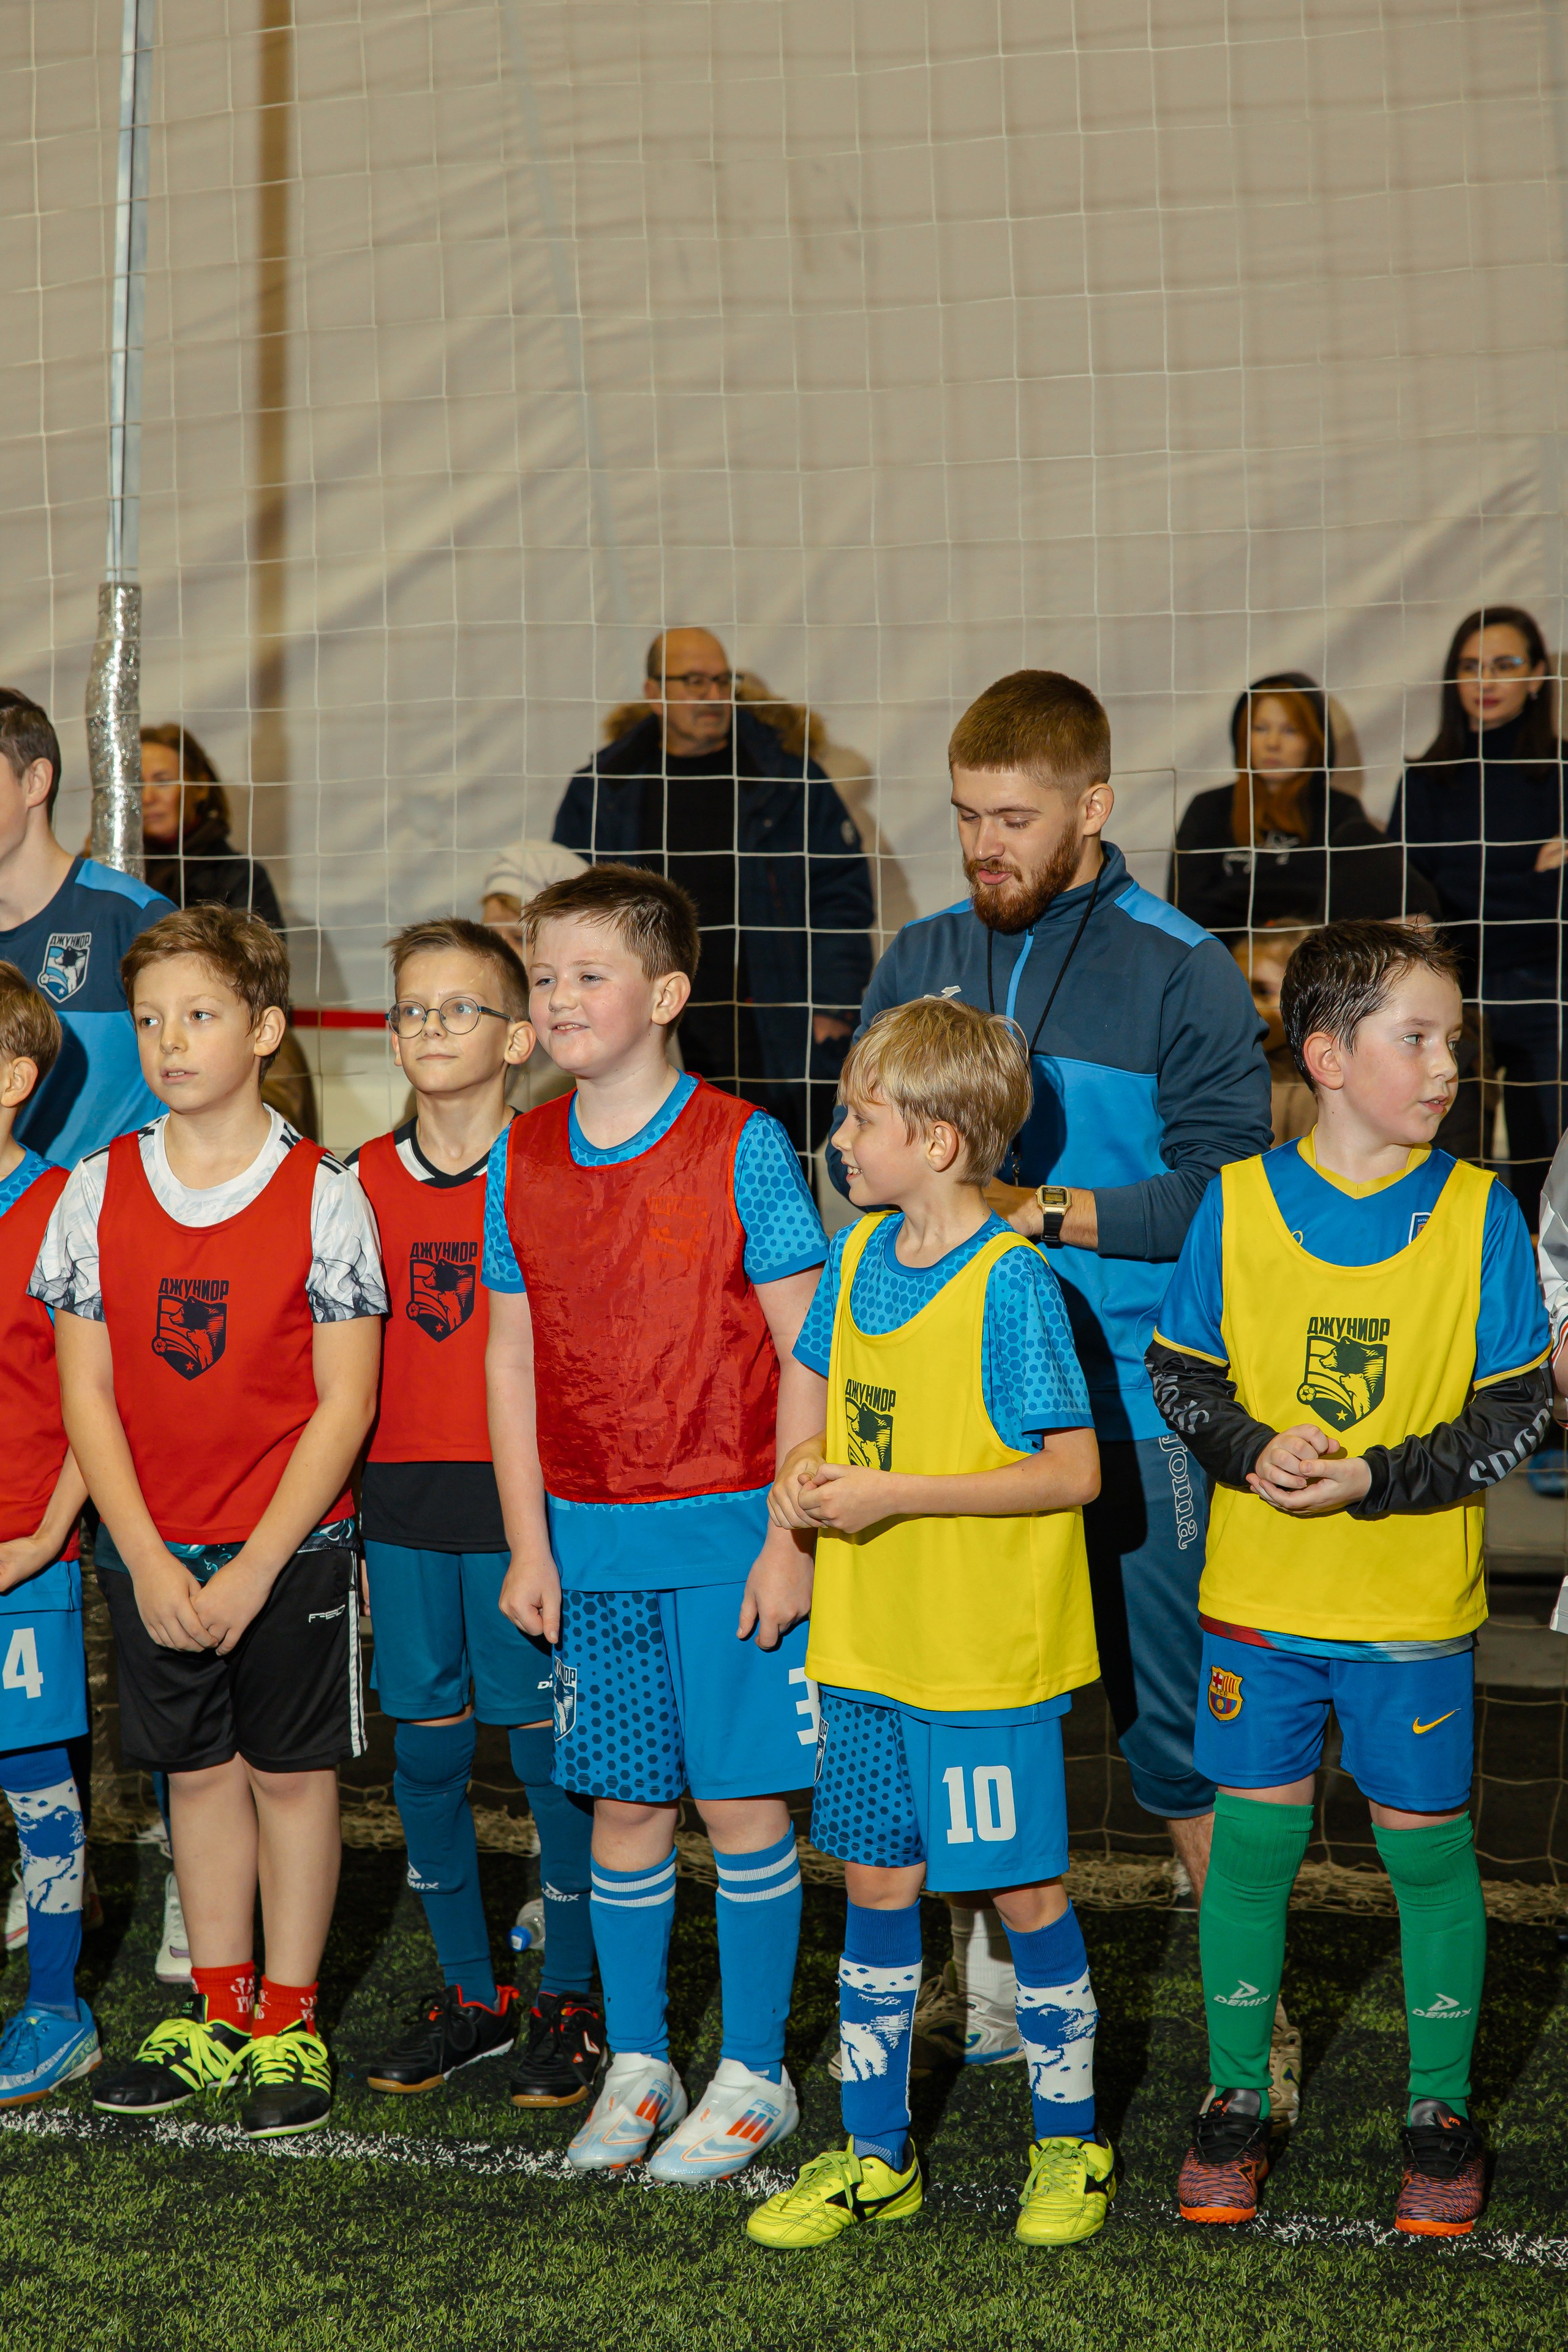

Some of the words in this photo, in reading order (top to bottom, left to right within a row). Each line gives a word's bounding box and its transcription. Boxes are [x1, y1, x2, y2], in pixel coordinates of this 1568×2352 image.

[50, 935, 89, 948] ДЖУНИОР
[409, 1242, 478, 1263] ДЖУНИОР
[158, 1278, 230, 1302] ДЖУНИОР
[1307, 1316, 1390, 1343] ДЖУНИОР
[845, 1378, 896, 1412] ДЖУНИОР
[2, 1627, 44, 1699] 4
[788, 1667, 821, 1746] 3
[942, 1765, 1017, 1844] 10
[1213, 1994, 1271, 2007] DEMIX
[1412, 2007, 1472, 2019] DEMIX
[750, 2098, 782, 2117] F50
